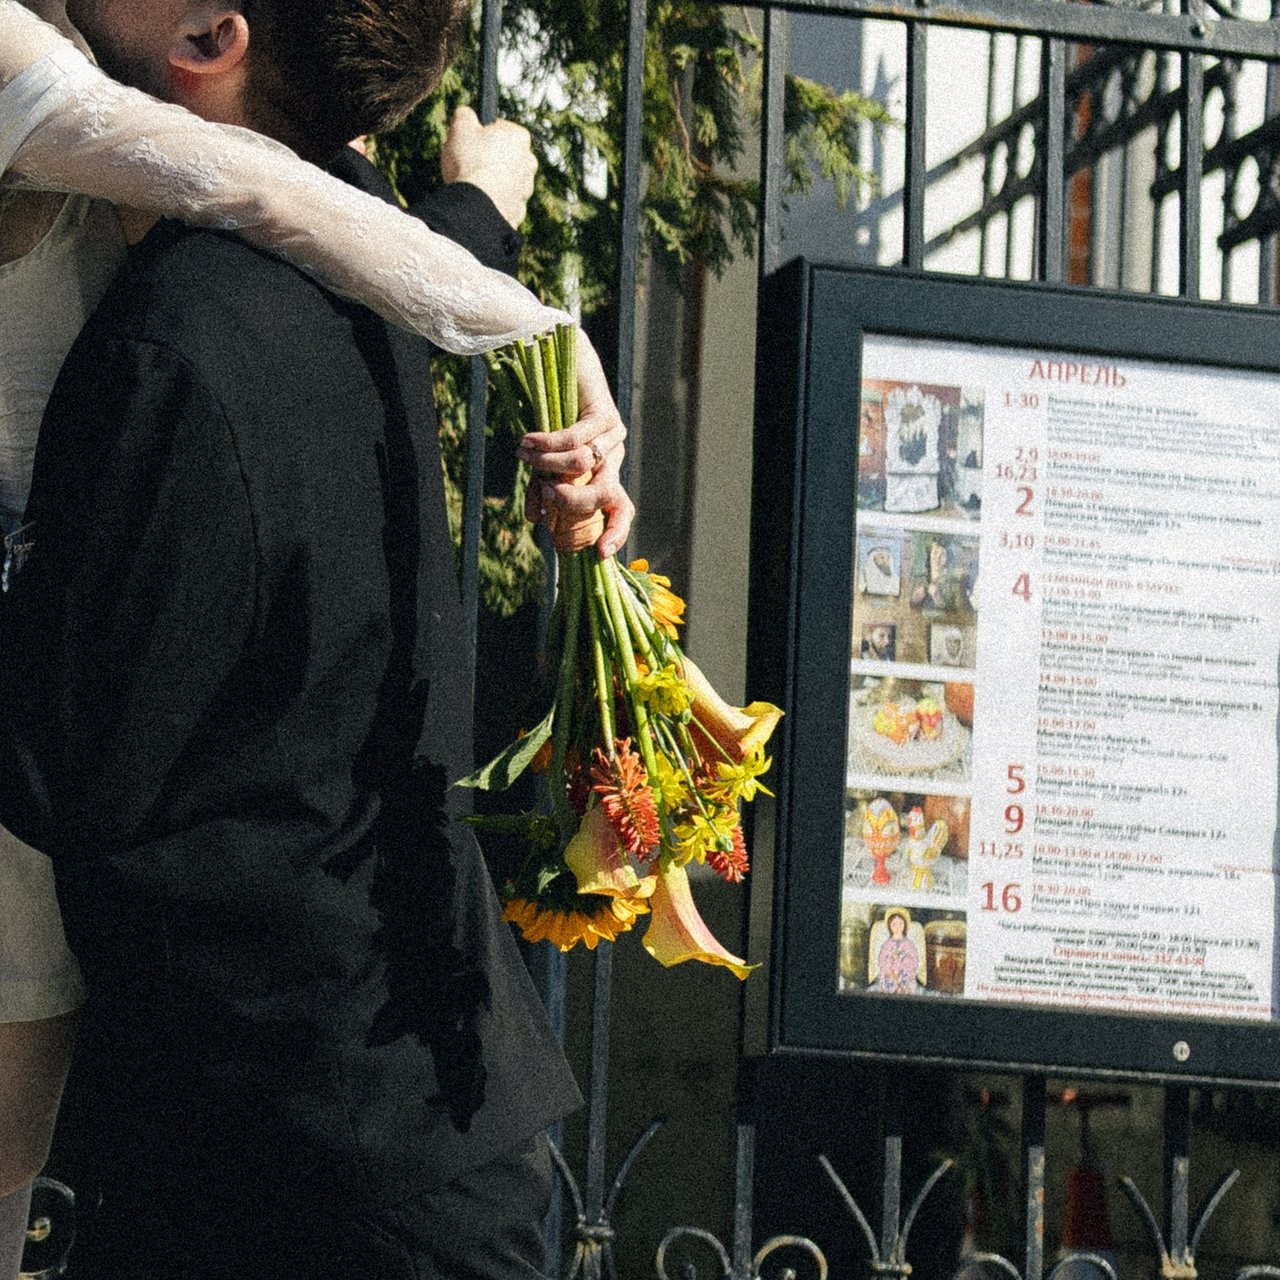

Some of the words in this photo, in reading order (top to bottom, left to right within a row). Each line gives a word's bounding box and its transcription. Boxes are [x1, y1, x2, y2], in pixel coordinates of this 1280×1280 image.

[1029, 359, 1128, 387] АПРЕЛЬ
[1015, 447, 1038, 464] 2,9
[995, 463, 1038, 483] 16,23
[1015, 486, 1035, 517] 2
[999, 533, 1035, 550] 3,10
[1011, 573, 1032, 603] 4
[1006, 763, 1026, 795] 5
[1004, 803, 1025, 835] 9
[979, 841, 1024, 860] 11,25
[980, 880, 1022, 913] 16
